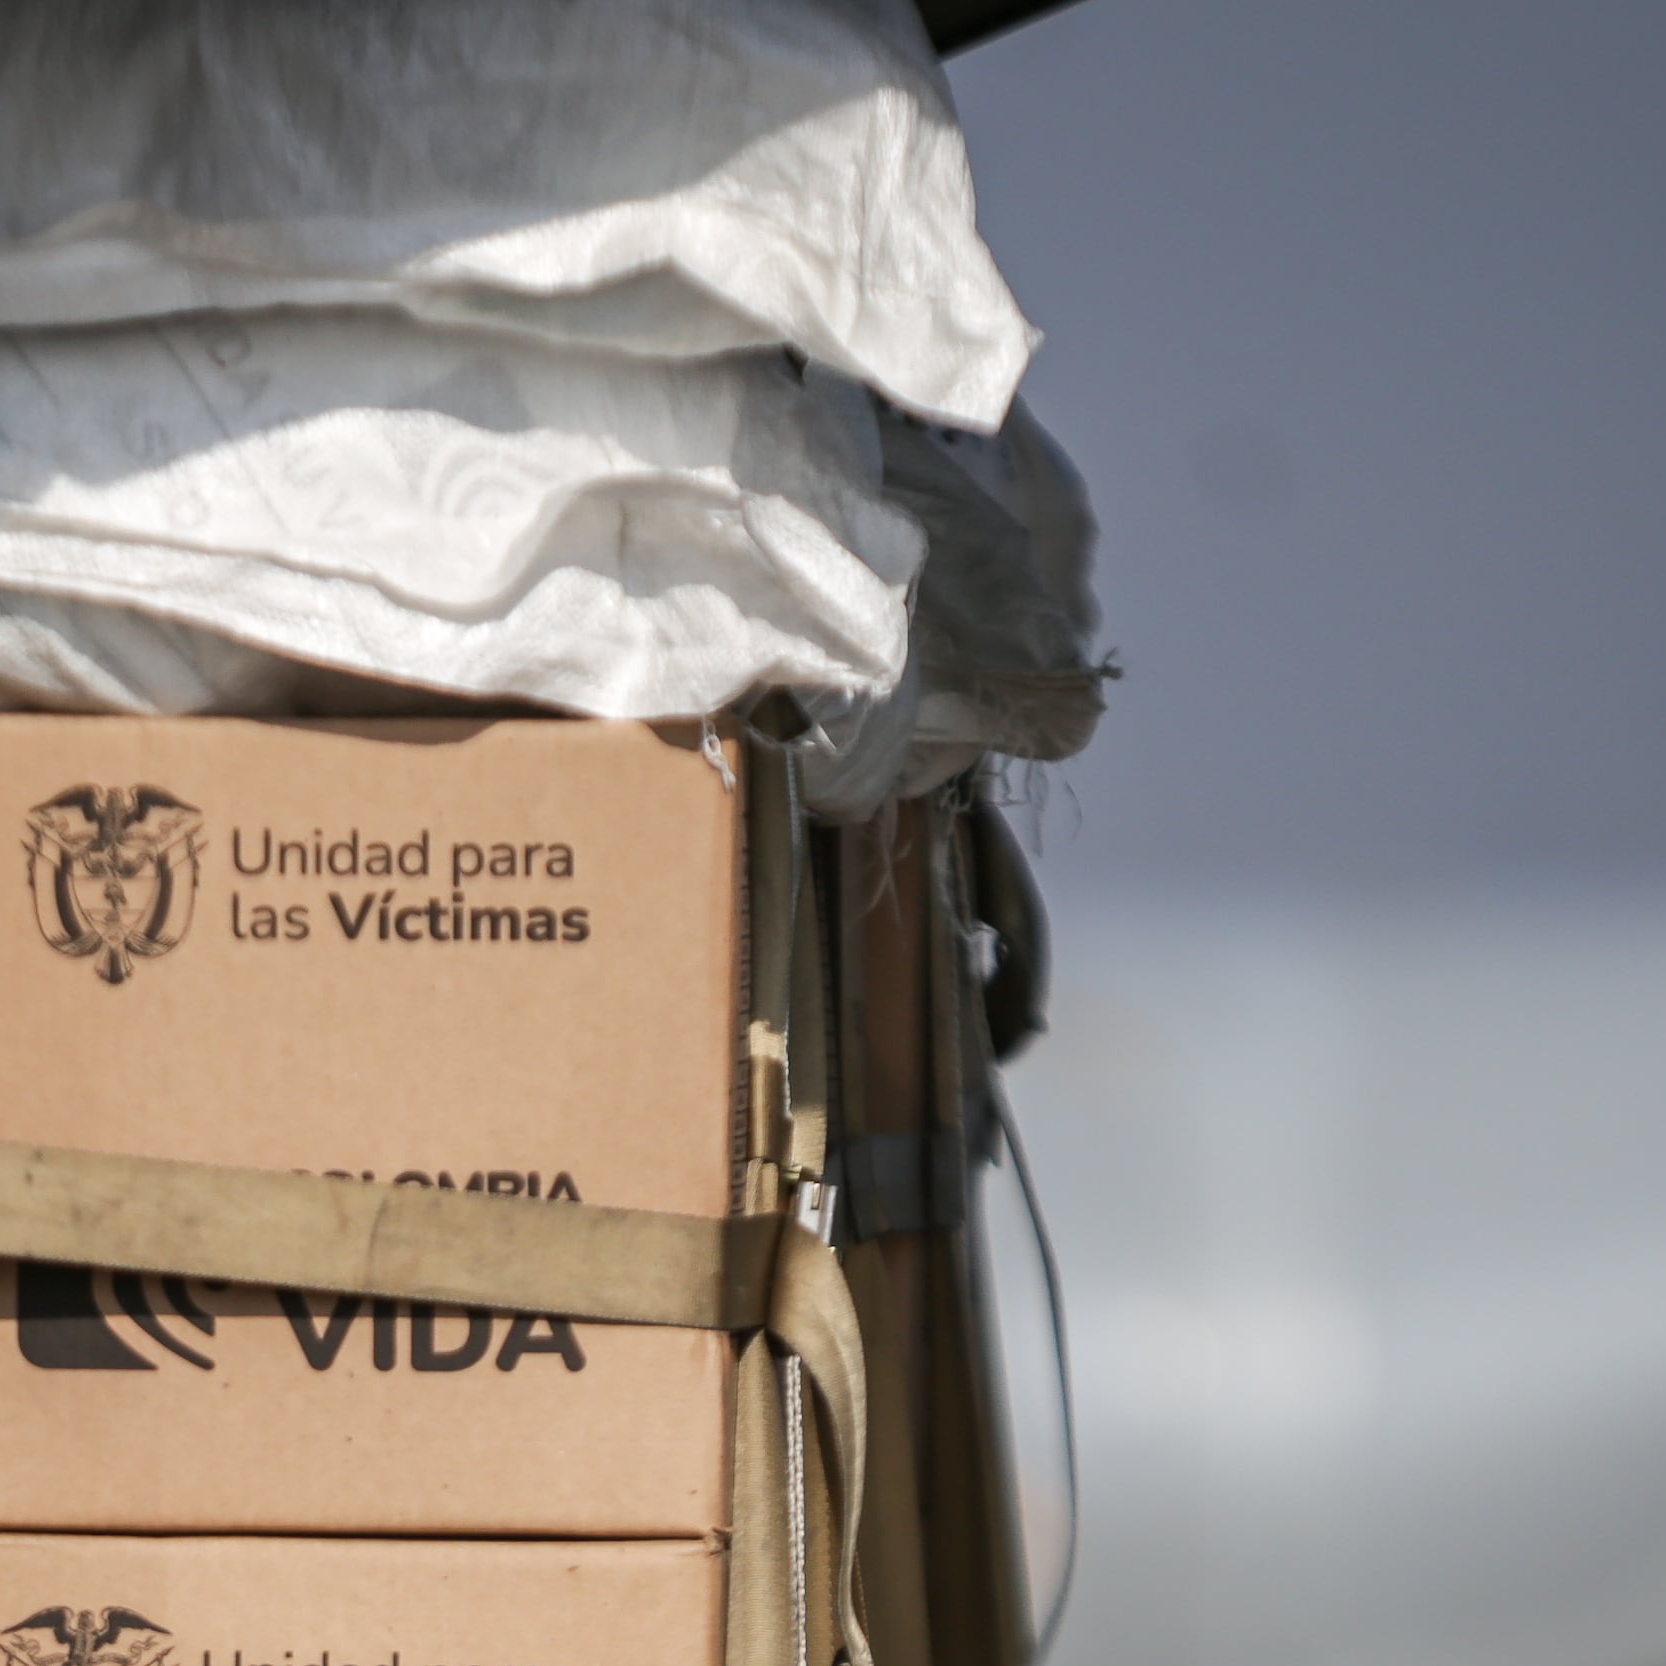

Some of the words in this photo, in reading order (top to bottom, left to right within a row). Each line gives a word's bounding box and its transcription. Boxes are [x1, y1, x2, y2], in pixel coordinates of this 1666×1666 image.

[231, 826, 430, 879] Unidad
[450, 840, 576, 888] para
[230, 890, 311, 941] las
[329, 889, 592, 943] Víctimas
[275, 1288, 588, 1373] VIDA
